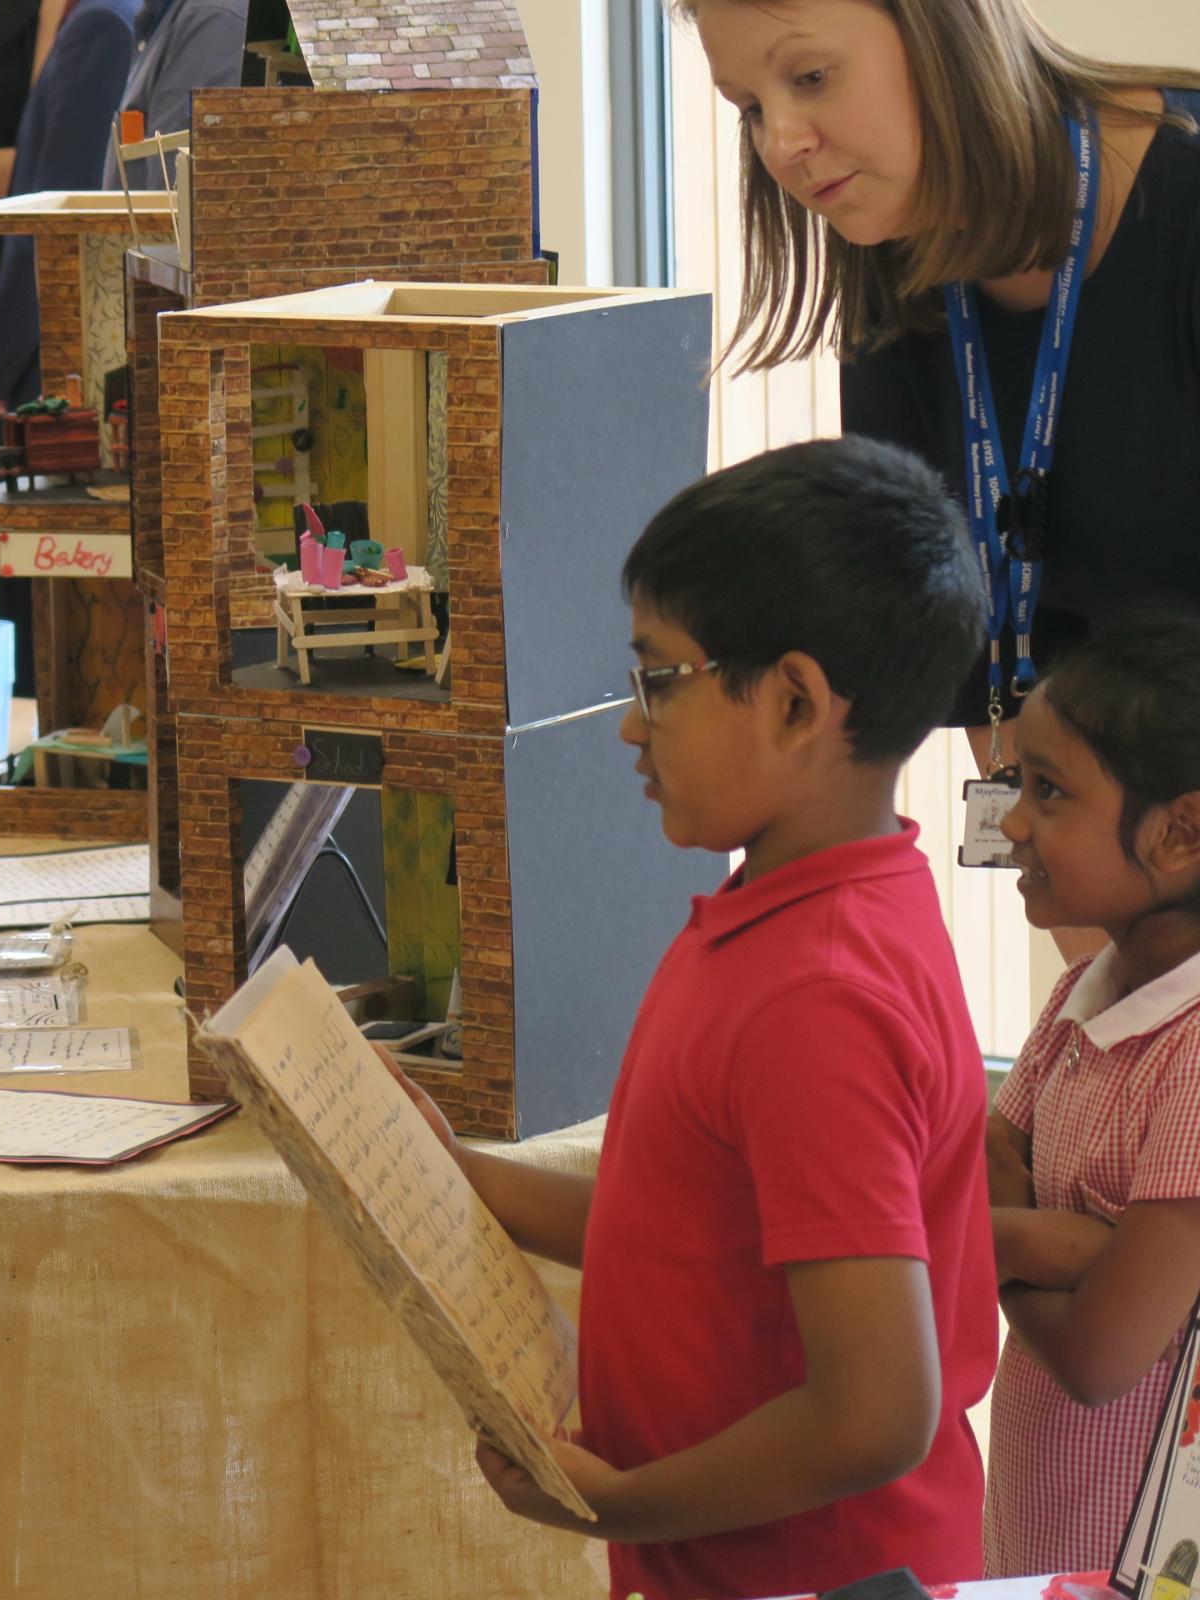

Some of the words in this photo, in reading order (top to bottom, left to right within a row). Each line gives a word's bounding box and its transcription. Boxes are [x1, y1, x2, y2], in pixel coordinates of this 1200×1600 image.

[982, 439, 995, 466] STAFF
[34, 536, 114, 575] Bakery
[1021, 561, 1033, 593] SCHOOL
[975, 787, 1018, 797] Mayflower
